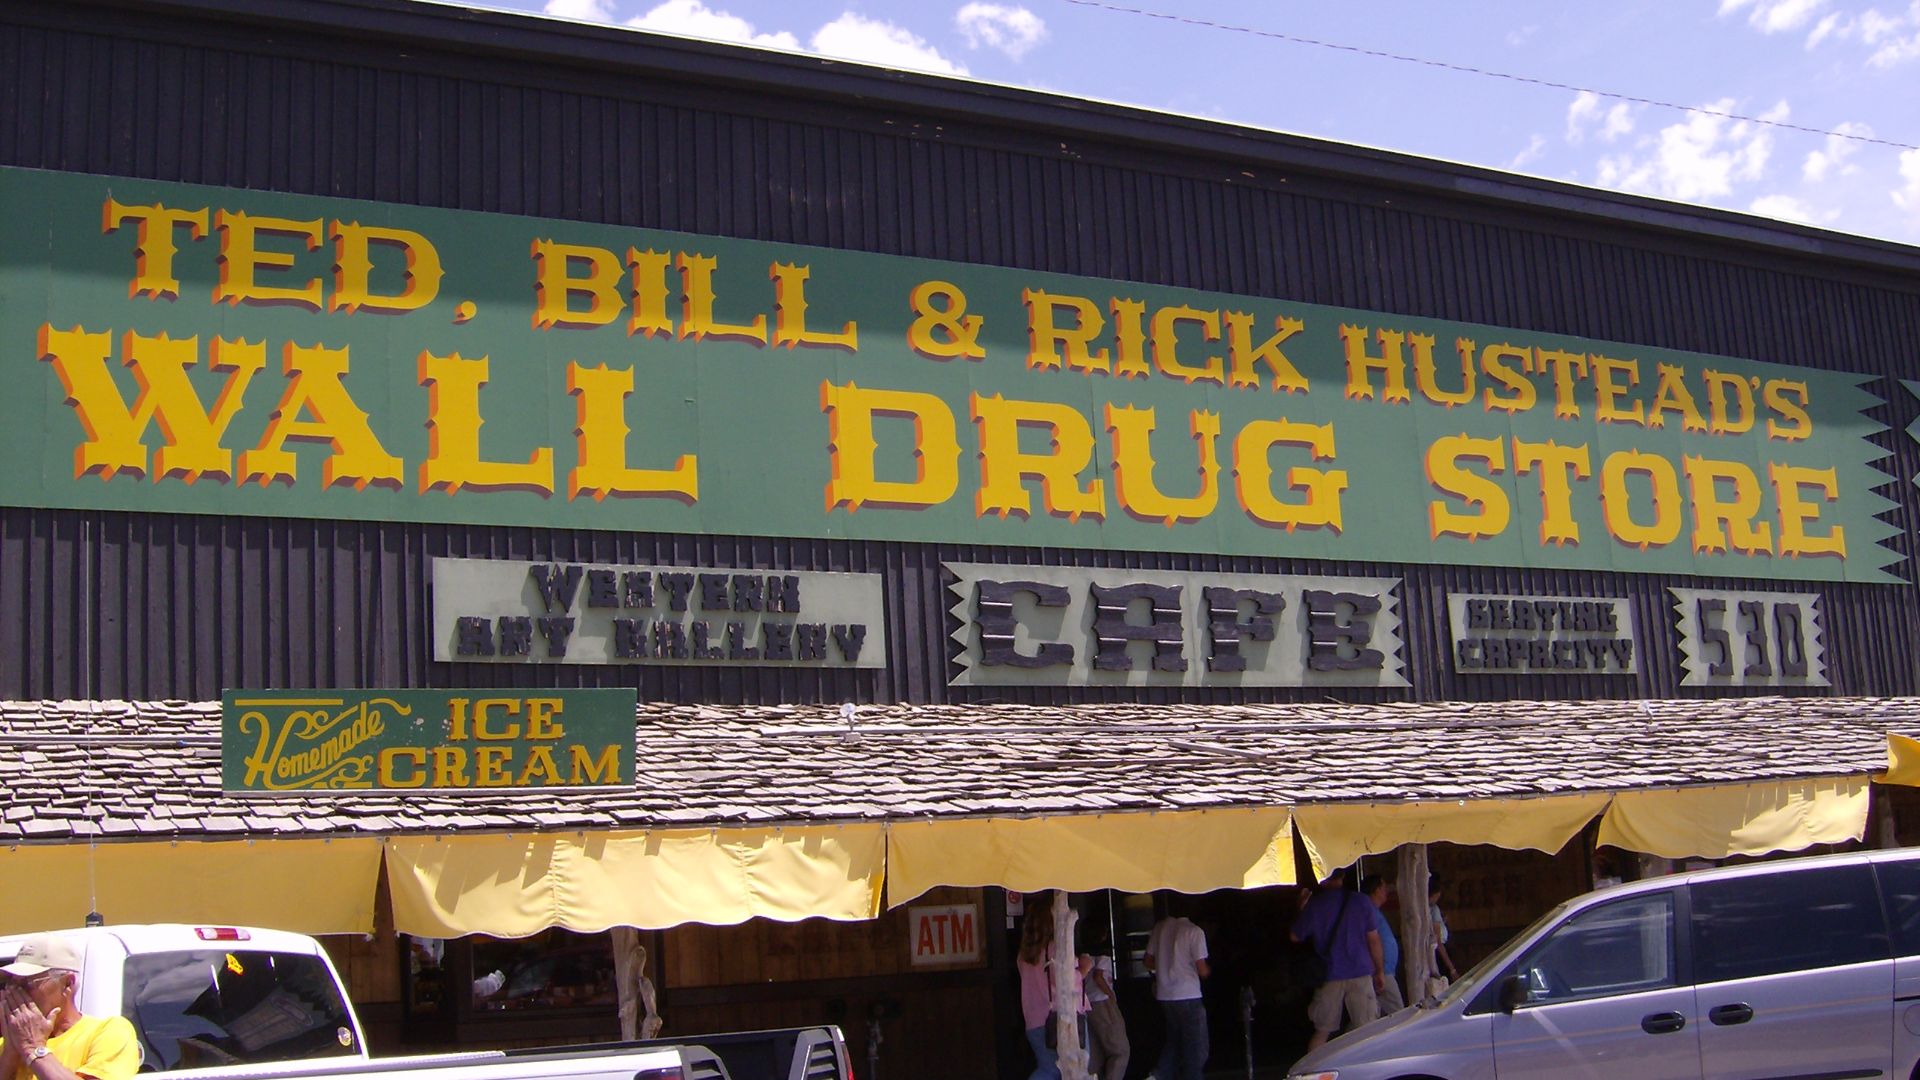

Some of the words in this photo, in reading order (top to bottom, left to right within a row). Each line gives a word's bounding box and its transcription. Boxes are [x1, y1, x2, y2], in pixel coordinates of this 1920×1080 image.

[531, 236, 858, 352] BILL
[907, 281, 986, 360] &
[1021, 287, 1310, 394] RICK
[1339, 322, 1813, 441] HUSTEAD'S
[37, 322, 698, 503] WALL
[822, 378, 1348, 534] DRUG
[1424, 430, 1847, 562] STORE
[529, 562, 800, 613] WESTERN
[455, 615, 576, 657] ART
[613, 616, 867, 662] GALLERY
[974, 579, 1385, 672] CAFE
[1467, 598, 1617, 633] SEATING
[1696, 598, 1808, 677] 530
[1457, 638, 1632, 669] CAPACITY
[448, 697, 564, 741] ICE
[239, 702, 392, 790] Homemade
[376, 743, 622, 788] CREAM
[916, 912, 974, 956] ATM
